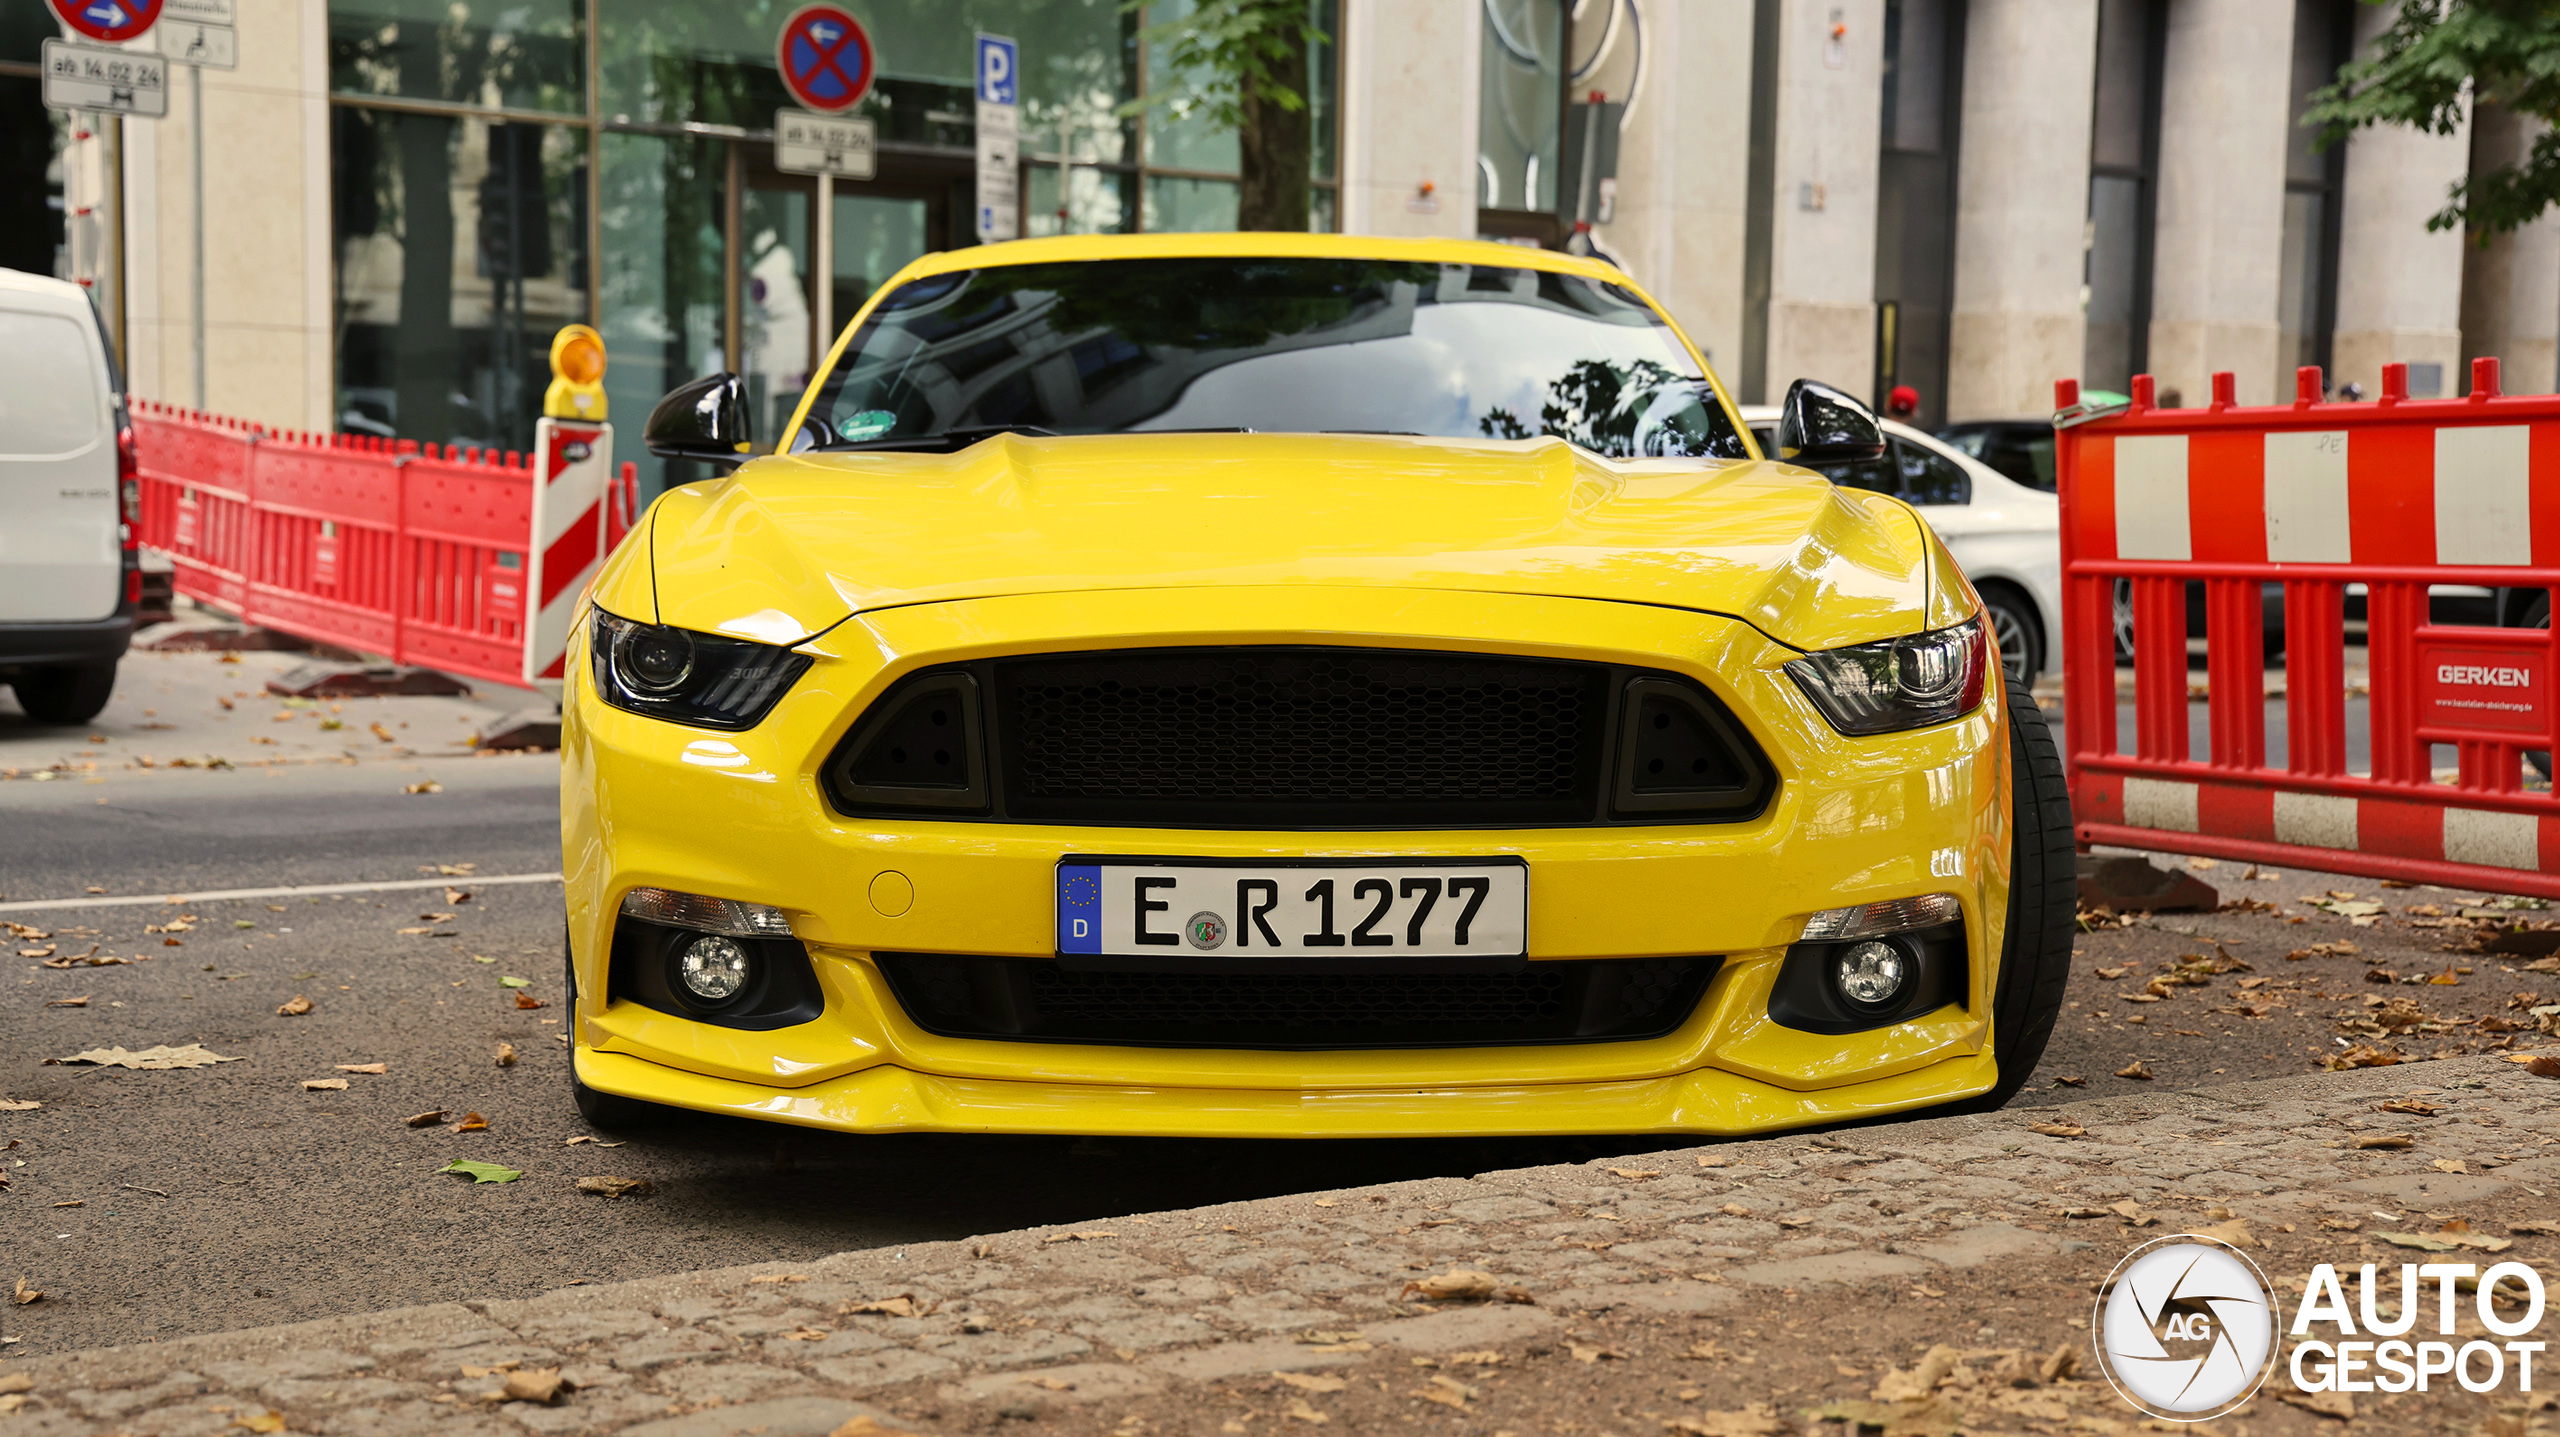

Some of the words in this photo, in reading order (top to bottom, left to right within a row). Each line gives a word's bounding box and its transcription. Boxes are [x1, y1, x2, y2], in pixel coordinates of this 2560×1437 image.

[2437, 665, 2530, 688] GERKEN
[1134, 876, 1180, 946] E
[1073, 919, 1088, 938] D
